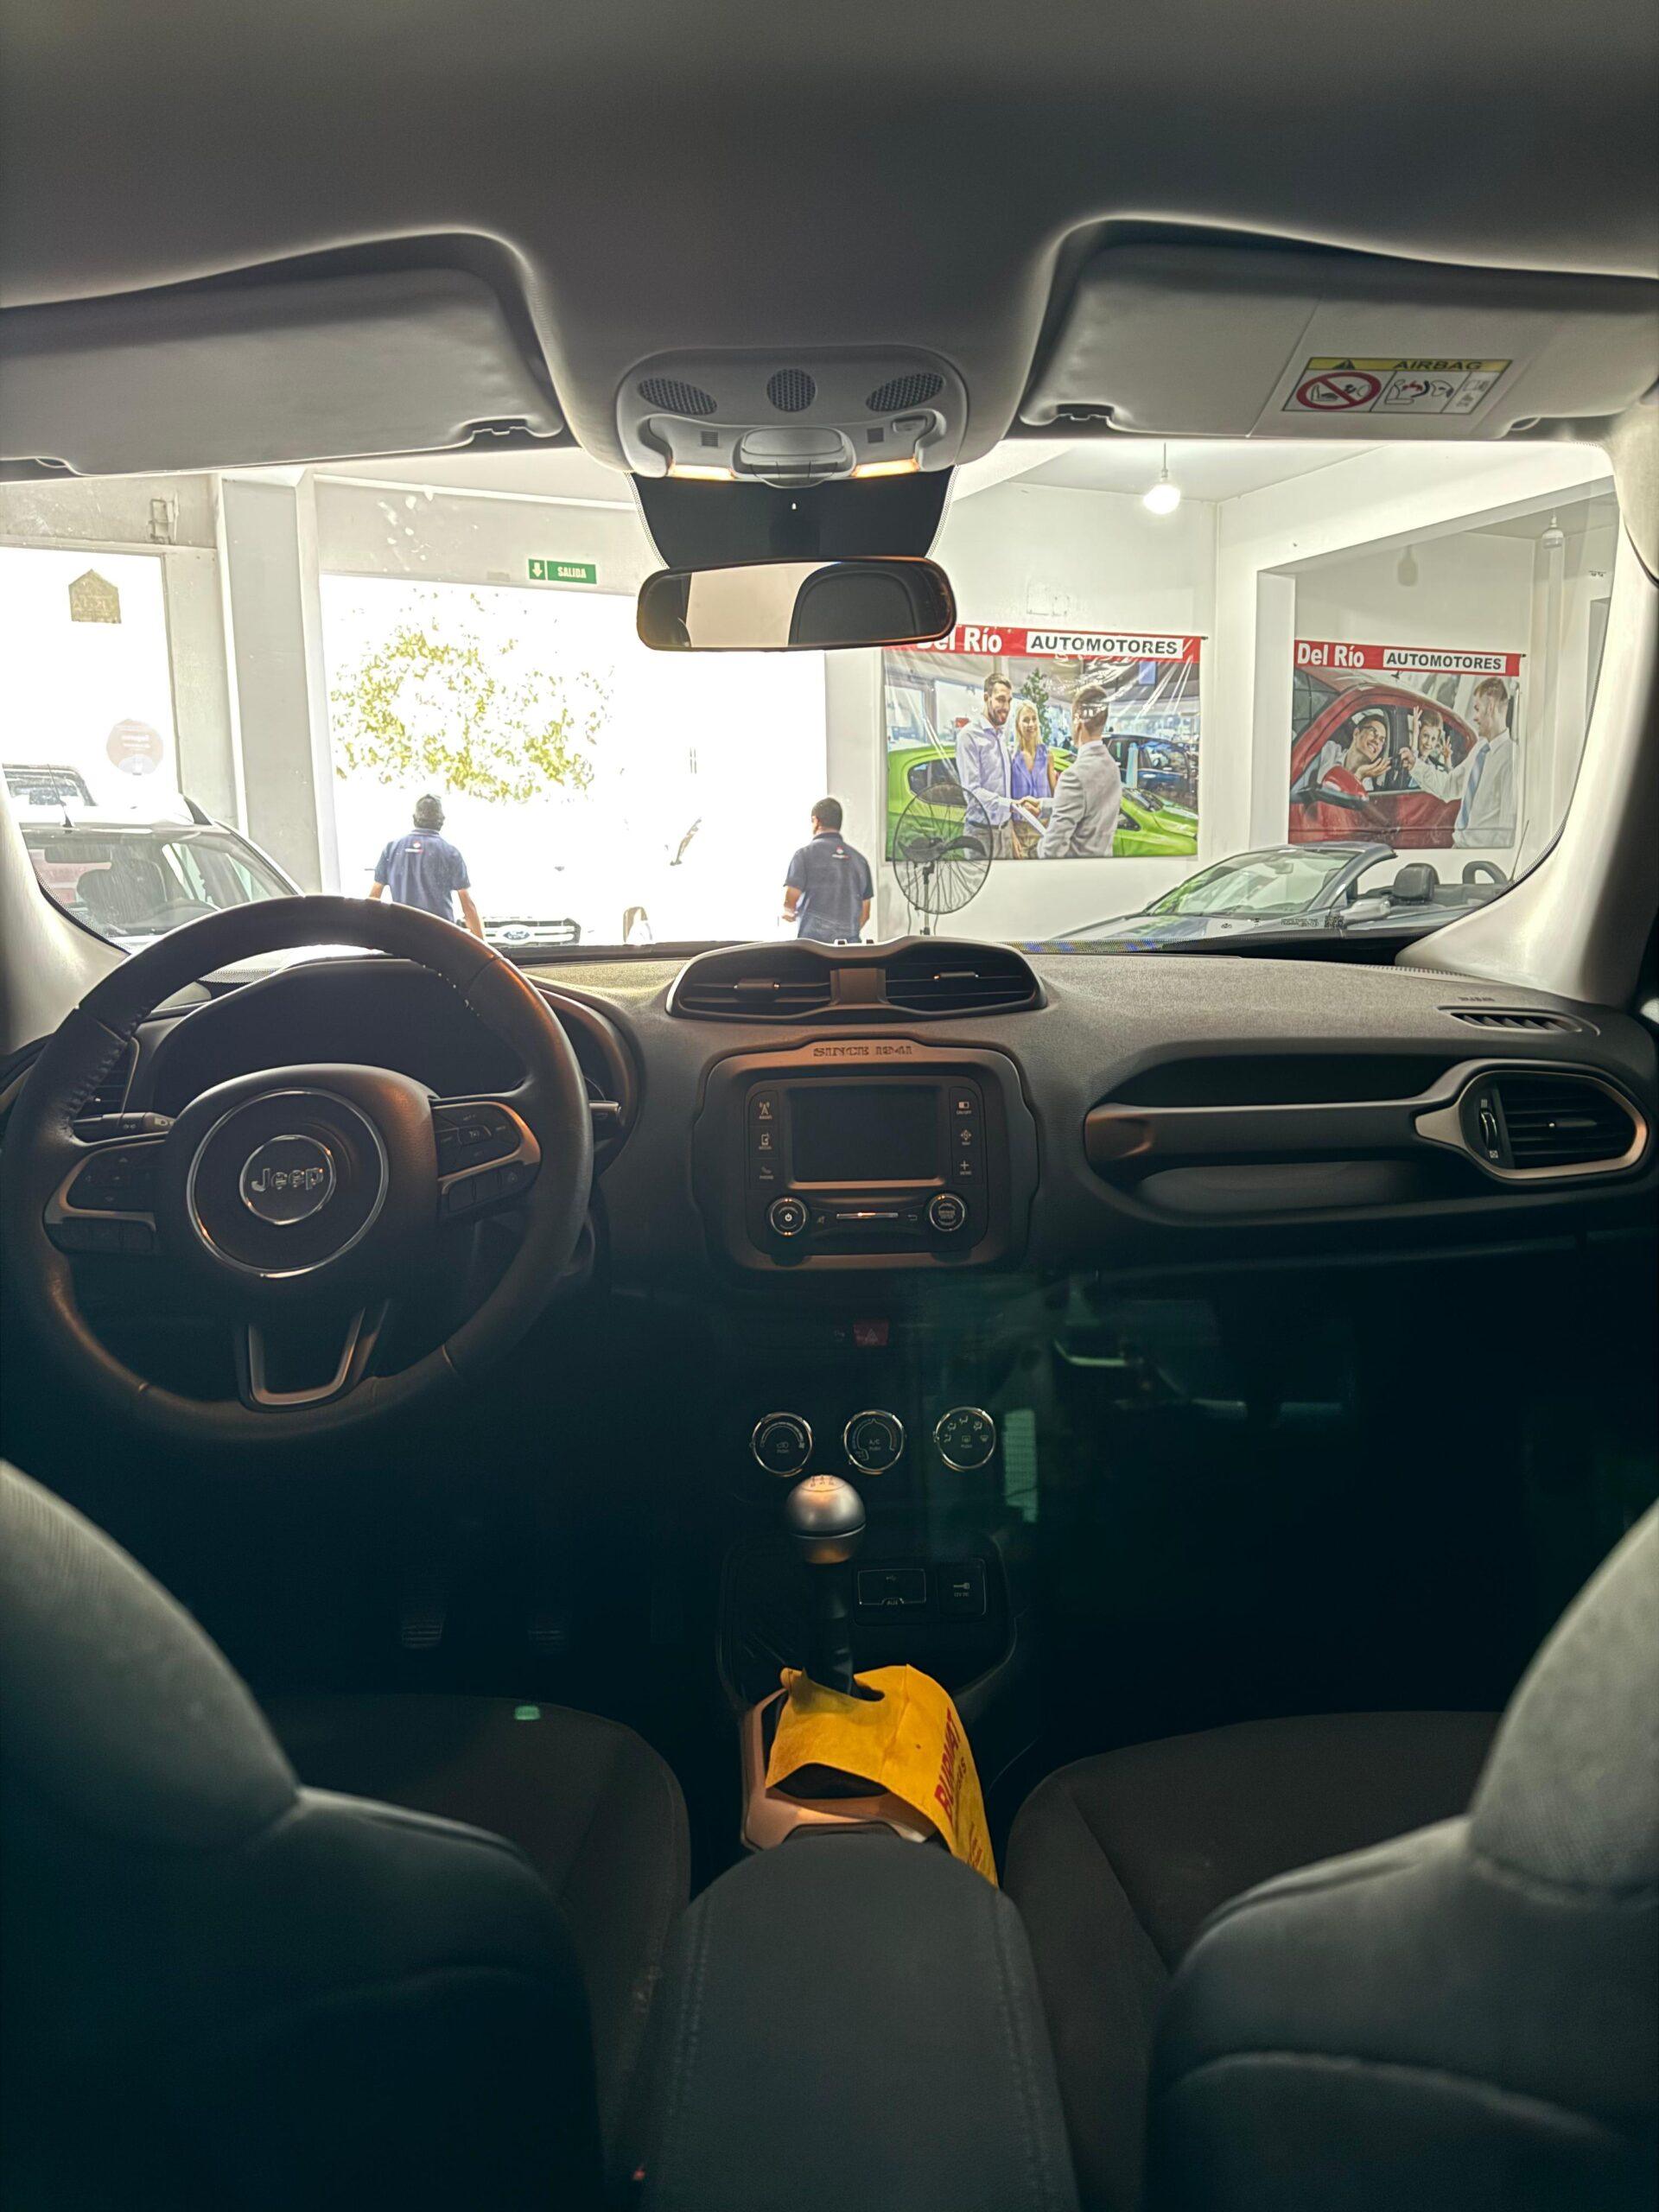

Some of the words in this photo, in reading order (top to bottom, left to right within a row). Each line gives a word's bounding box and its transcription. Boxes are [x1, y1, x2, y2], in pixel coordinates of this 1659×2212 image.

[1393, 359, 1483, 371] AIRBAG
[557, 566, 587, 578] SALIDA
[963, 626, 1002, 653] Río
[1031, 635, 1178, 655] AUTOMOTORES
[1297, 642, 1329, 665] Del
[1334, 645, 1364, 668] Río
[1386, 652, 1502, 670] AUTOMOTORES
[813, 1046, 869, 1057] SINCE
[875, 1046, 912, 1055] 1941
[251, 1166, 324, 1192] Jeep
